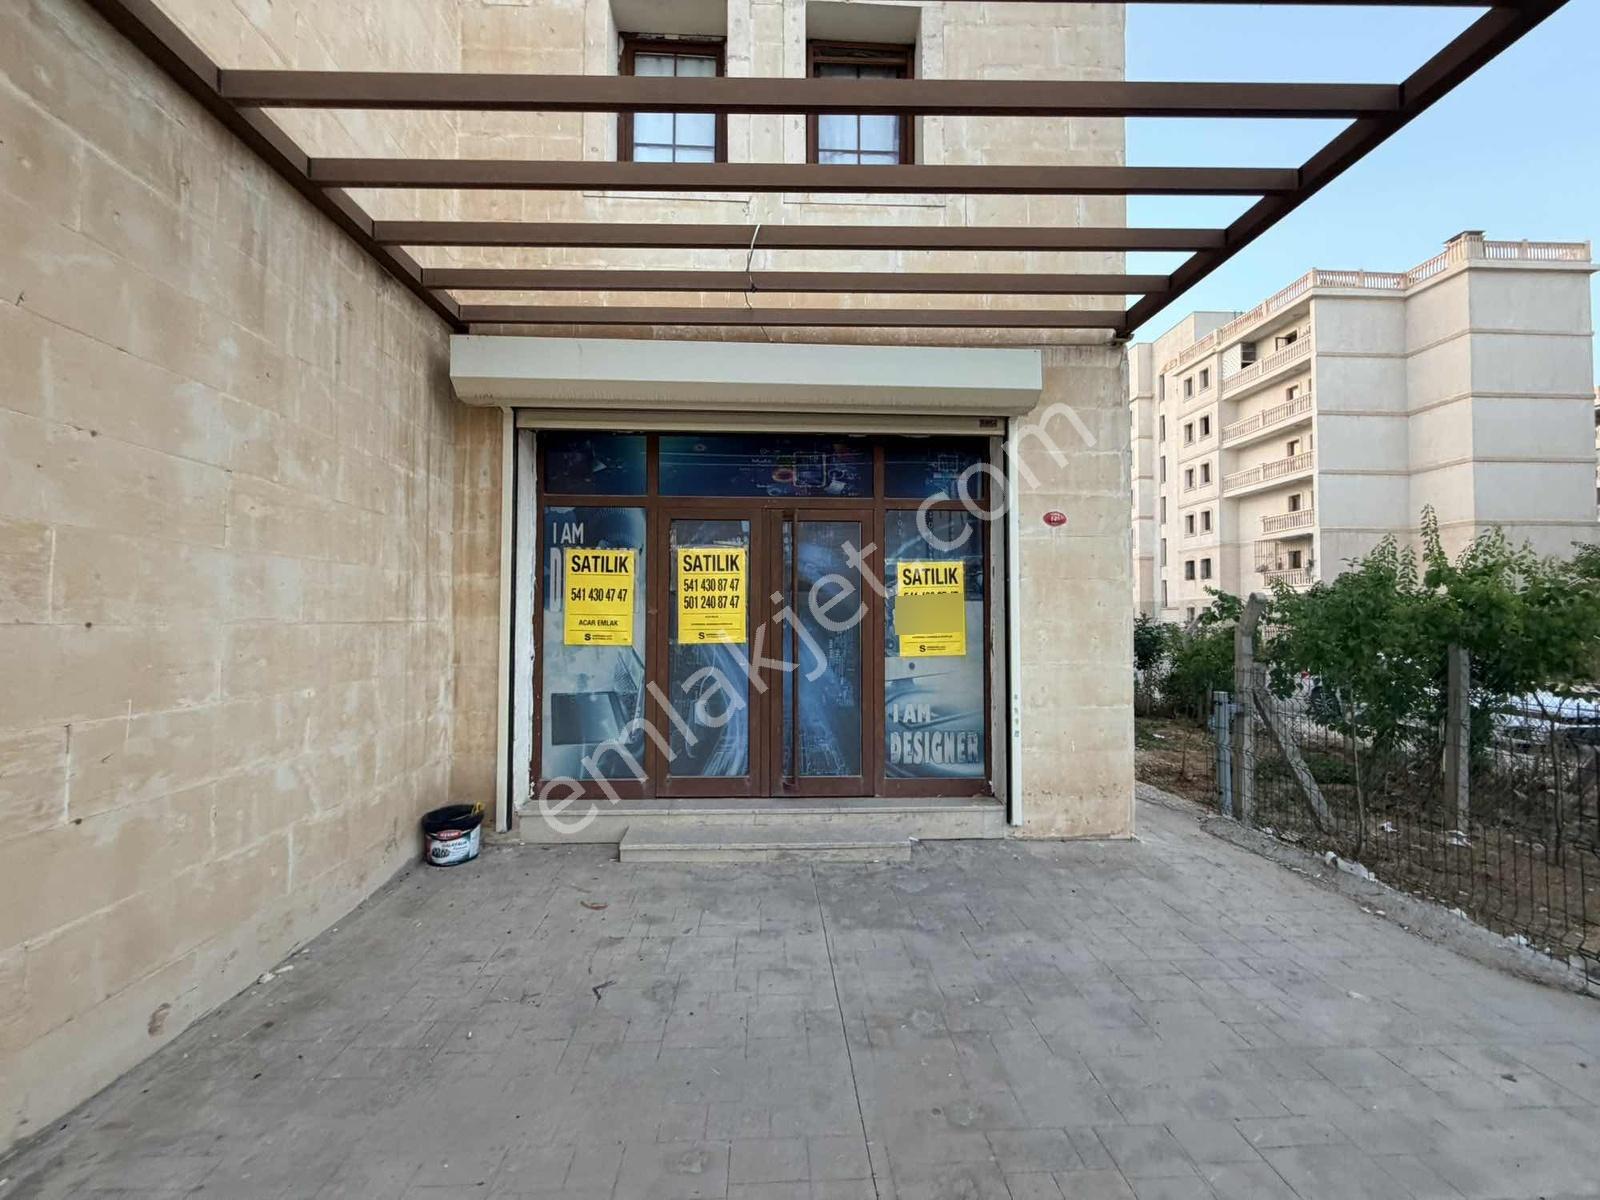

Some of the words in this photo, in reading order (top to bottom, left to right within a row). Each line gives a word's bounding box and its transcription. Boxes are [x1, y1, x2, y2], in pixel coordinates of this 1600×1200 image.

[552, 521, 557, 545] I
[560, 521, 584, 545] AM
[571, 554, 629, 574] SATILIK
[683, 554, 740, 572] SATILIK
[683, 578, 699, 592] 541
[700, 578, 716, 592] 430
[717, 578, 728, 592] 87
[729, 578, 740, 592] 47
[902, 567, 959, 586] SATILIK
[571, 587, 586, 601] 541
[588, 587, 604, 602] 430
[605, 588, 616, 602] 47
[617, 588, 628, 602] 47
[683, 595, 699, 609] 501
[700, 595, 716, 609] 240
[717, 595, 728, 609] 87
[729, 595, 740, 609] 47
[597, 619, 618, 627] EMLAK
[893, 703, 899, 724] I
[902, 703, 931, 724] AM
[890, 730, 979, 765] DESIGNER
